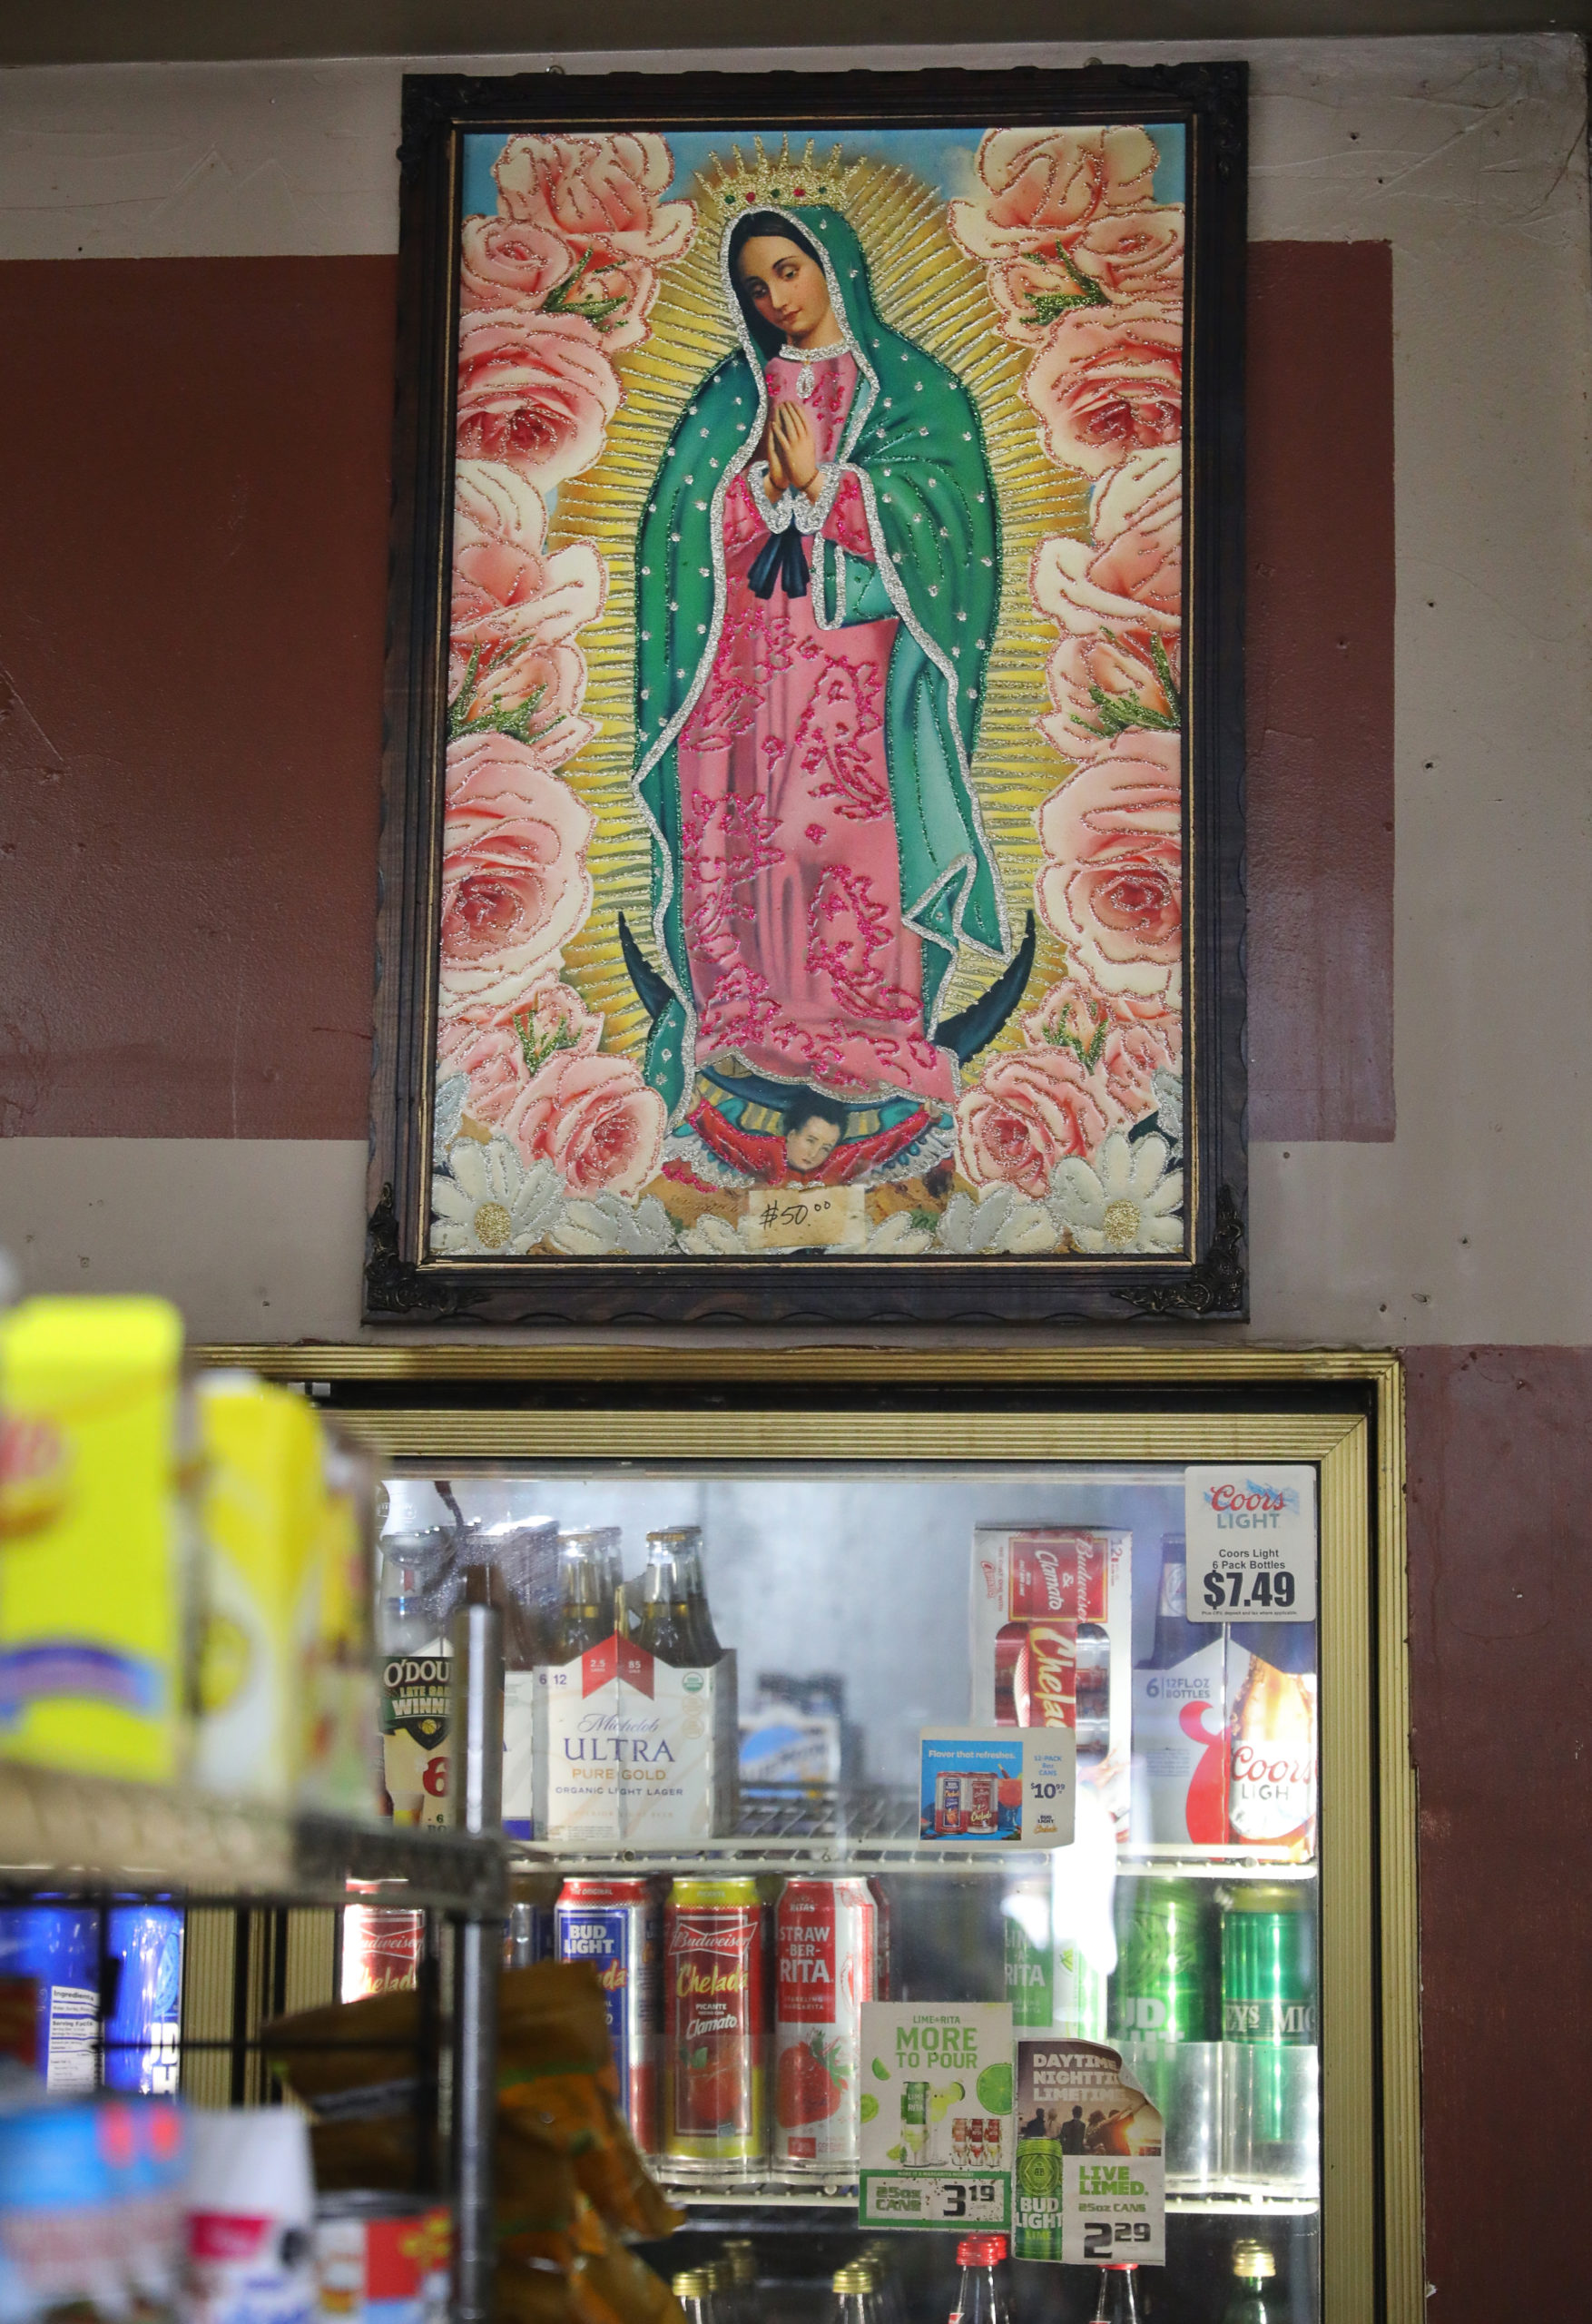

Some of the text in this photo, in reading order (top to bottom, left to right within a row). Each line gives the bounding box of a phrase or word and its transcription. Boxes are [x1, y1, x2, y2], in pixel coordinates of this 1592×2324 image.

[1210, 1484, 1286, 1512] Coors
[1217, 1513, 1281, 1529] LIGHT
[1219, 1549, 1279, 1560] Coors Light
[1213, 1561, 1286, 1570] 6 Pack Bottles
[1035, 1550, 1065, 1610] Clamato
[1063, 1572, 1075, 1589] &
[1076, 1537, 1095, 1623] Budweiser
[1204, 1570, 1295, 1610] $7.49
[384, 1658, 450, 1688] O'DOU
[539, 1674, 567, 1685] 6 12
[1029, 1627, 1076, 1728] Chela
[1146, 1678, 1160, 1699] 6
[1165, 1689, 1210, 1699] BOTTLES
[577, 1713, 661, 1733] Michelob
[564, 1738, 675, 1762] ULTRA
[929, 1750, 955, 1758] Flavor
[957, 1750, 974, 1758] that
[572, 1768, 666, 1780] PURE GOLD
[1231, 1746, 1312, 1786] Coors
[555, 1787, 604, 1795] ORGANIC
[608, 1787, 643, 1796] LIGHT
[1242, 1783, 1289, 1800] LIGH
[570, 1925, 606, 1939] BUD
[673, 1930, 752, 1949] Budweiser
[780, 1926, 830, 1942] STRAW
[565, 1939, 614, 1954] LIGHT
[677, 1963, 748, 1996] Chelada
[780, 1959, 830, 1984] RITA
[1005, 1964, 1046, 1986] RITA
[686, 2014, 738, 2040] Clamato
[896, 2027, 978, 2051] MORE
[895, 2052, 978, 2069] TO POUR
[1079, 2165, 1130, 2181] LIVE
[1079, 2181, 1149, 2196] LIMED.
[876, 2199, 921, 2211] CANS
[1020, 2197, 1059, 2213] BUD
[1114, 2203, 1146, 2212] CANS
[1016, 2212, 1063, 2229] LIGHT
[1026, 2230, 1052, 2240] LIME
